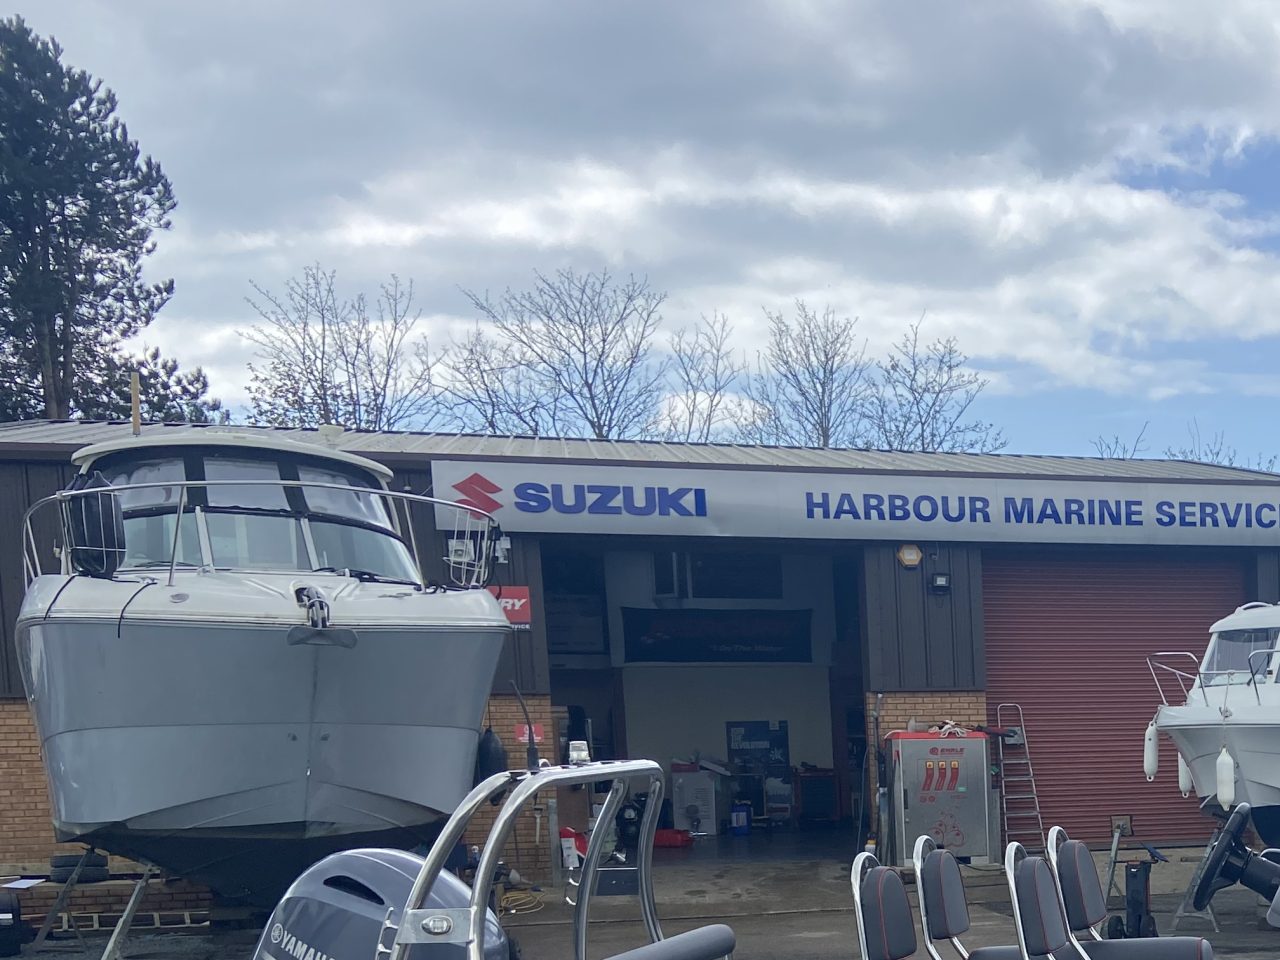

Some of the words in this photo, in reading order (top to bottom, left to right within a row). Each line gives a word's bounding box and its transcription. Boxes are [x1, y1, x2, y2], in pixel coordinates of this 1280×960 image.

[513, 482, 708, 517] SUZUKI
[805, 491, 992, 523] HARBOUR
[1003, 496, 1144, 527] MARINE
